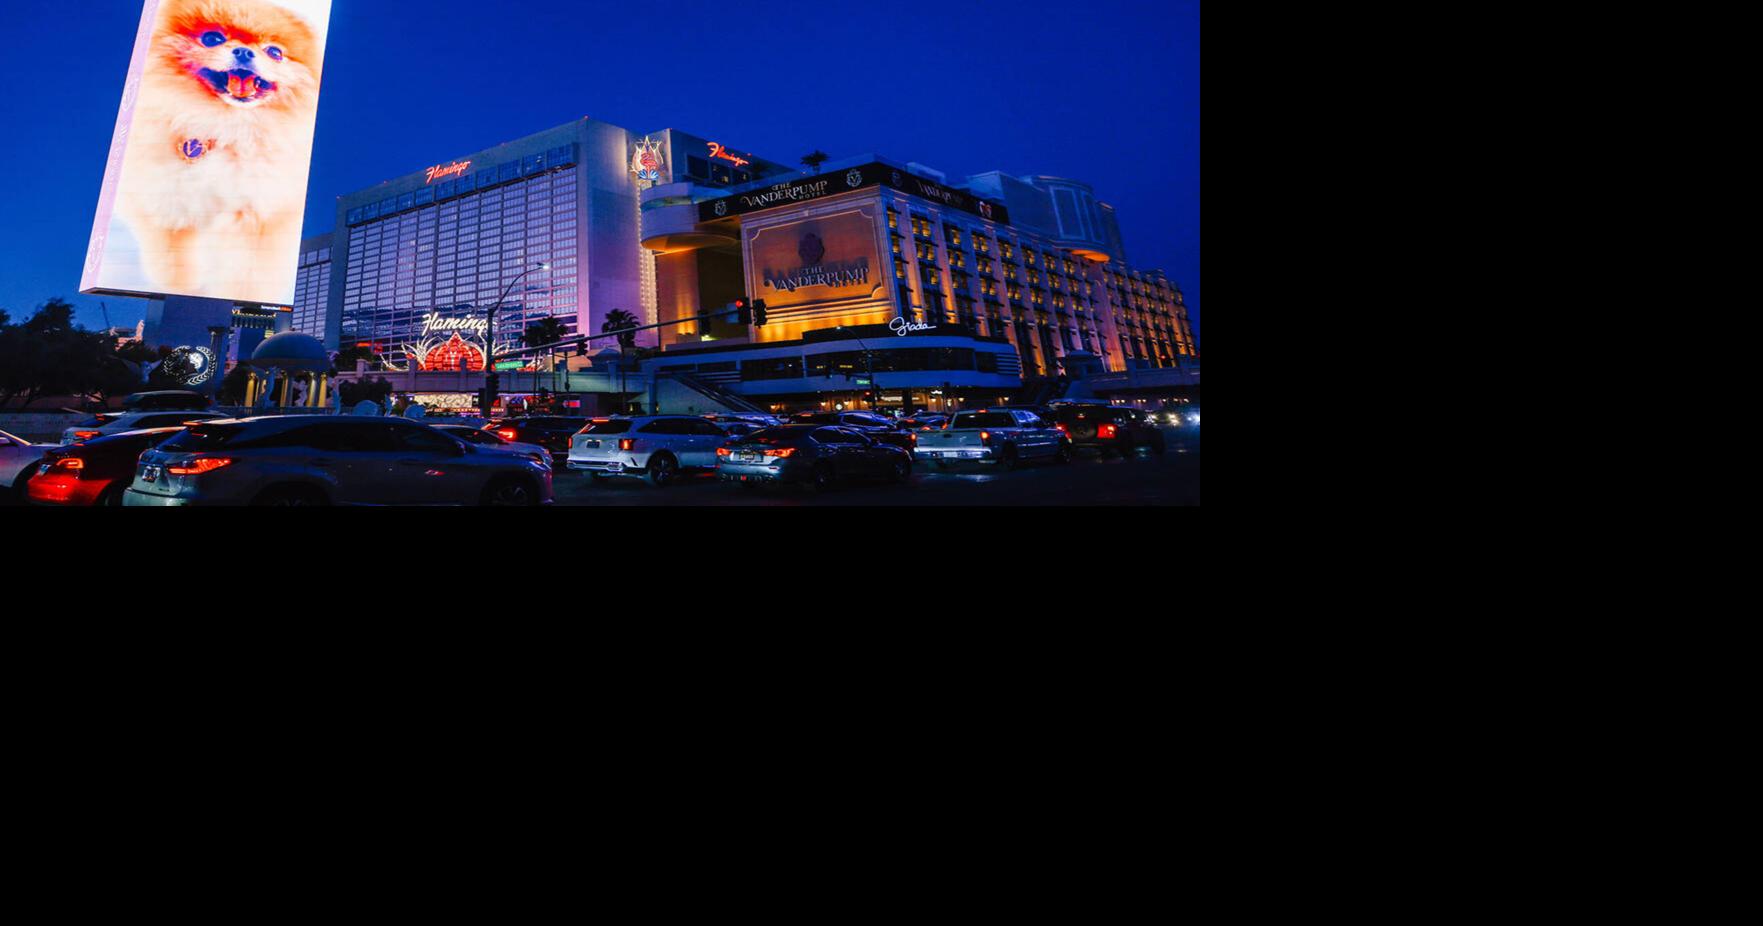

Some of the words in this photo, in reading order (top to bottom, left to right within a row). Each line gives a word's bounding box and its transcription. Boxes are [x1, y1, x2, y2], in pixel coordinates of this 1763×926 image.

[706, 141, 749, 167] Flamingo
[425, 160, 472, 185] Flamingo
[739, 181, 828, 207] VANDERPUMP
[771, 182, 791, 191] THE
[766, 267, 869, 292] VANDERPUMP
[422, 311, 498, 337] Flaming
[889, 316, 938, 337] Giada
